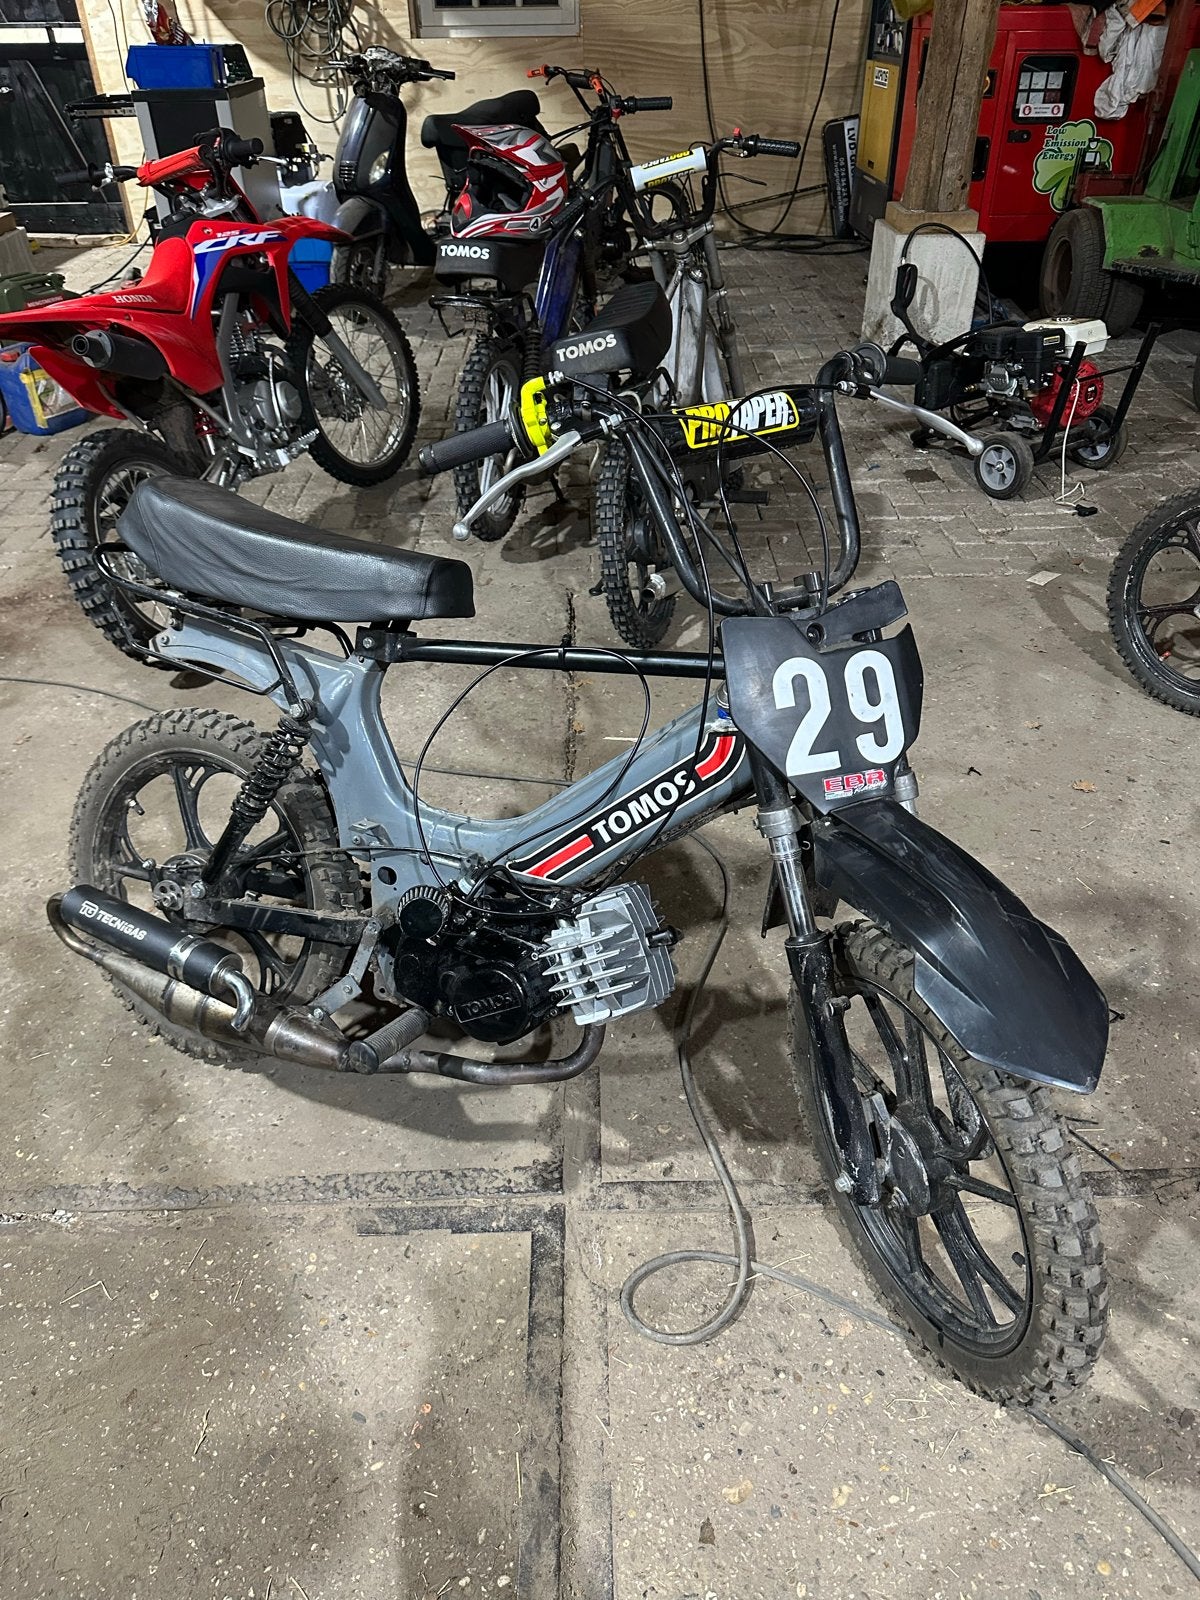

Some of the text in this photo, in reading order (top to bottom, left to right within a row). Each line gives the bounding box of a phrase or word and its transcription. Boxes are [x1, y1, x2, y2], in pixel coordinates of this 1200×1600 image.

[847, 127, 857, 151] LVD
[1046, 126, 1067, 135] Low
[1044, 138, 1087, 148] Emission
[1041, 151, 1076, 161] Energy
[193, 230, 282, 254] CRF
[215, 230, 240, 238] 125
[440, 244, 490, 260] TOMOS
[111, 294, 158, 303] HONDA
[556, 333, 617, 362] TOMOS
[772, 649, 905, 777] 29
[824, 769, 885, 793] EBR
[590, 770, 696, 843] TOMOS
